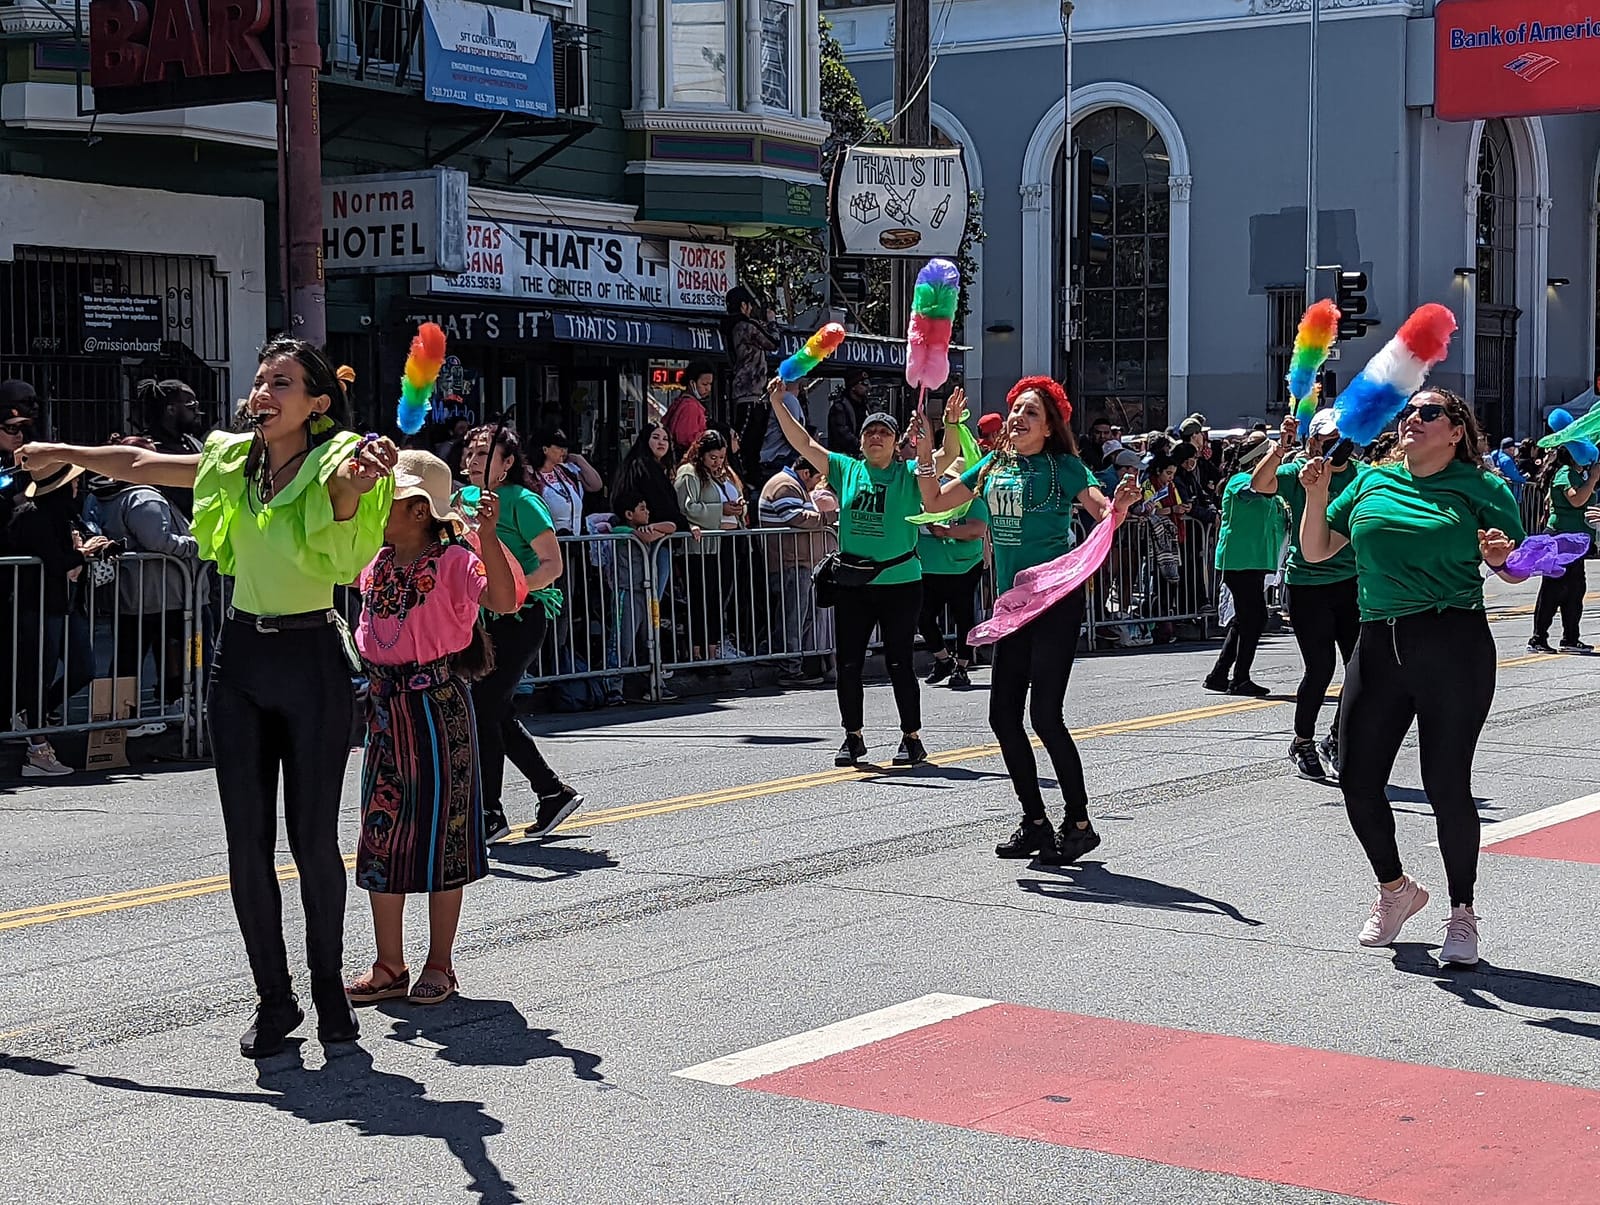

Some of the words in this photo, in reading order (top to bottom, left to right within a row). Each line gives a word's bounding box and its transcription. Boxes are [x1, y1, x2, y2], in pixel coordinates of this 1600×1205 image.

[89, 0, 275, 87] BAR
[471, 34, 517, 53] CONSTRUCTION
[1450, 25, 1503, 49] Bank
[1505, 23, 1527, 44] of
[1529, 16, 1600, 43] Americ
[853, 153, 926, 187] THAT'S
[934, 158, 954, 187] IT
[332, 189, 414, 218] Norma
[322, 222, 425, 260] HOTEL
[519, 230, 623, 274] THAT'S
[680, 246, 726, 269] TORTAS
[520, 276, 544, 293] THE
[547, 278, 593, 298] CENTER
[597, 281, 612, 298] OF
[615, 283, 636, 301] THE
[639, 286, 662, 303] MILE
[677, 269, 728, 292] CUBANA
[565, 315, 617, 341] THAT'S
[689, 327, 712, 350] THE
[83, 336, 162, 352] @missionbarsf
[844, 341, 885, 363] TORTA
